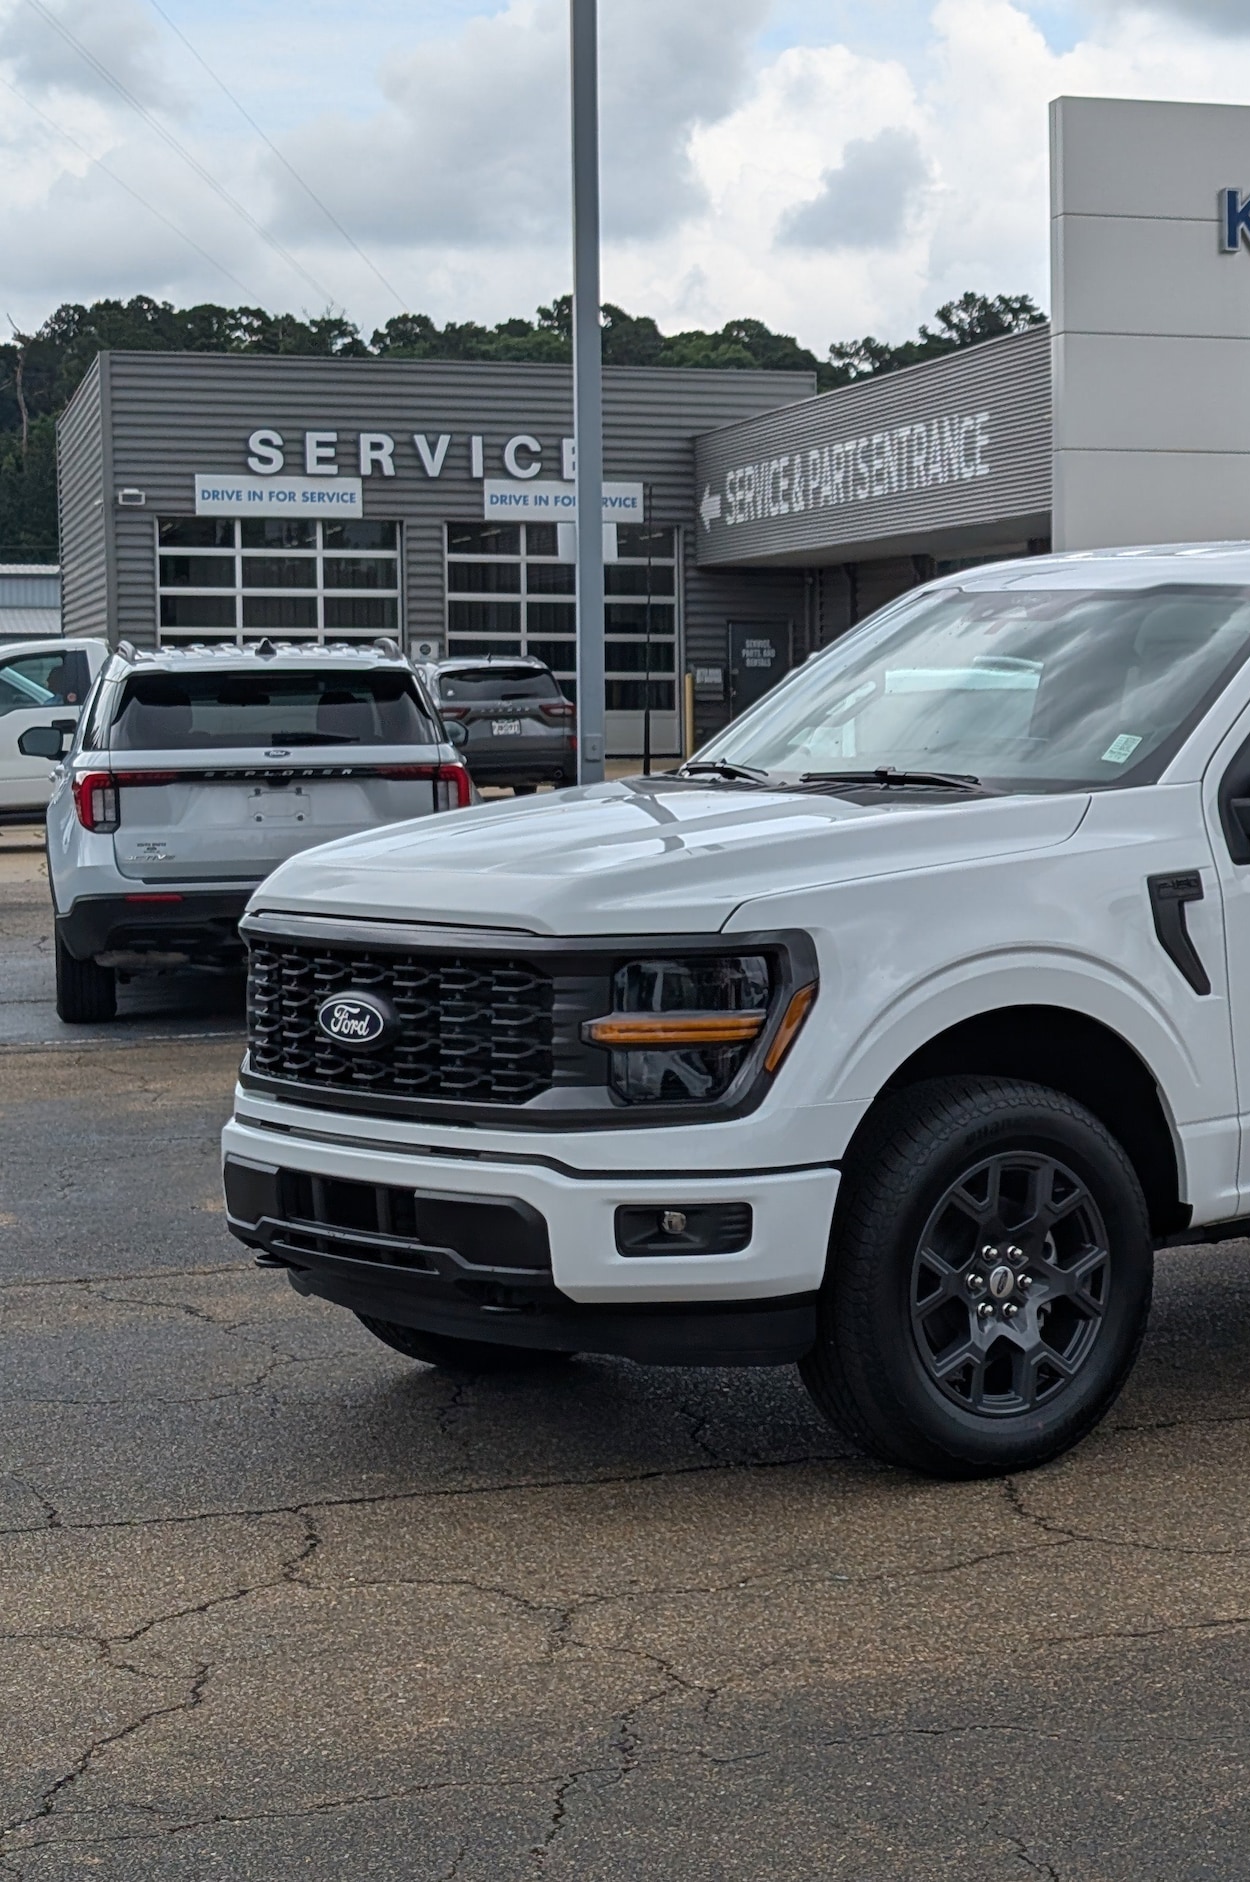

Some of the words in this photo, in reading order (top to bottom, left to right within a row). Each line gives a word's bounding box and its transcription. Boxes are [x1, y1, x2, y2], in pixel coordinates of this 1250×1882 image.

[725, 455, 790, 526] SERVICE
[808, 436, 869, 510] PARTS
[871, 411, 991, 497] ENTRANCE
[201, 489, 243, 502] DRIVE
[247, 490, 263, 502] IN
[268, 490, 297, 503] FOR
[301, 491, 357, 504] SERVICE
[489, 494, 530, 506] DRIVE
[534, 495, 549, 507] IN
[203, 768, 353, 778] EXPLORER
[330, 1004, 371, 1036] Ford
